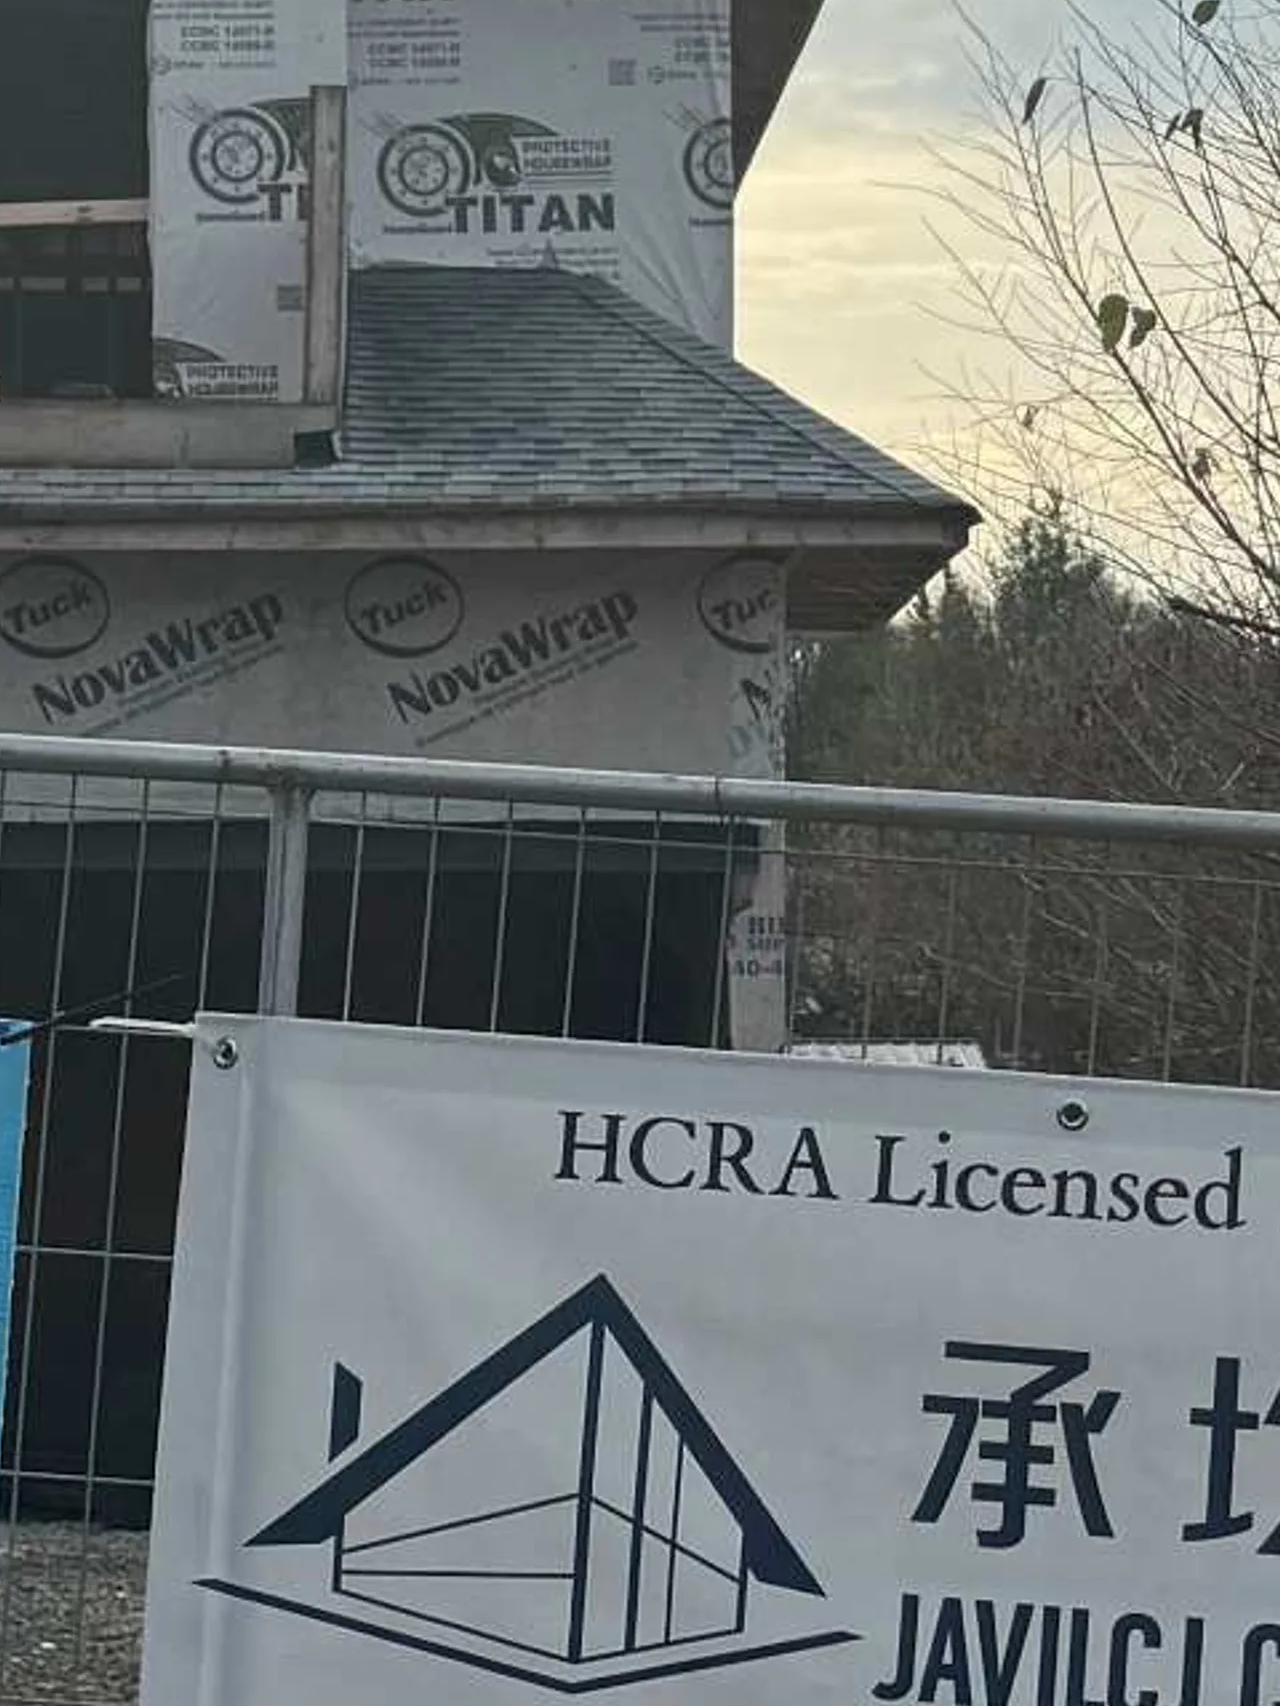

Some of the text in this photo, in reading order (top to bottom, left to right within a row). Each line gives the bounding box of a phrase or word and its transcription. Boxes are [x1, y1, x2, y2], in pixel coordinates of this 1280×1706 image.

[445, 195, 615, 233] TITAN
[2, 582, 93, 634] Tuck
[359, 579, 448, 635] Tuck
[31, 592, 283, 725] NovaWrap
[386, 592, 639, 725] NovaWrap
[555, 1110, 838, 1200] HCRA
[868, 1131, 1246, 1231] Licensed
